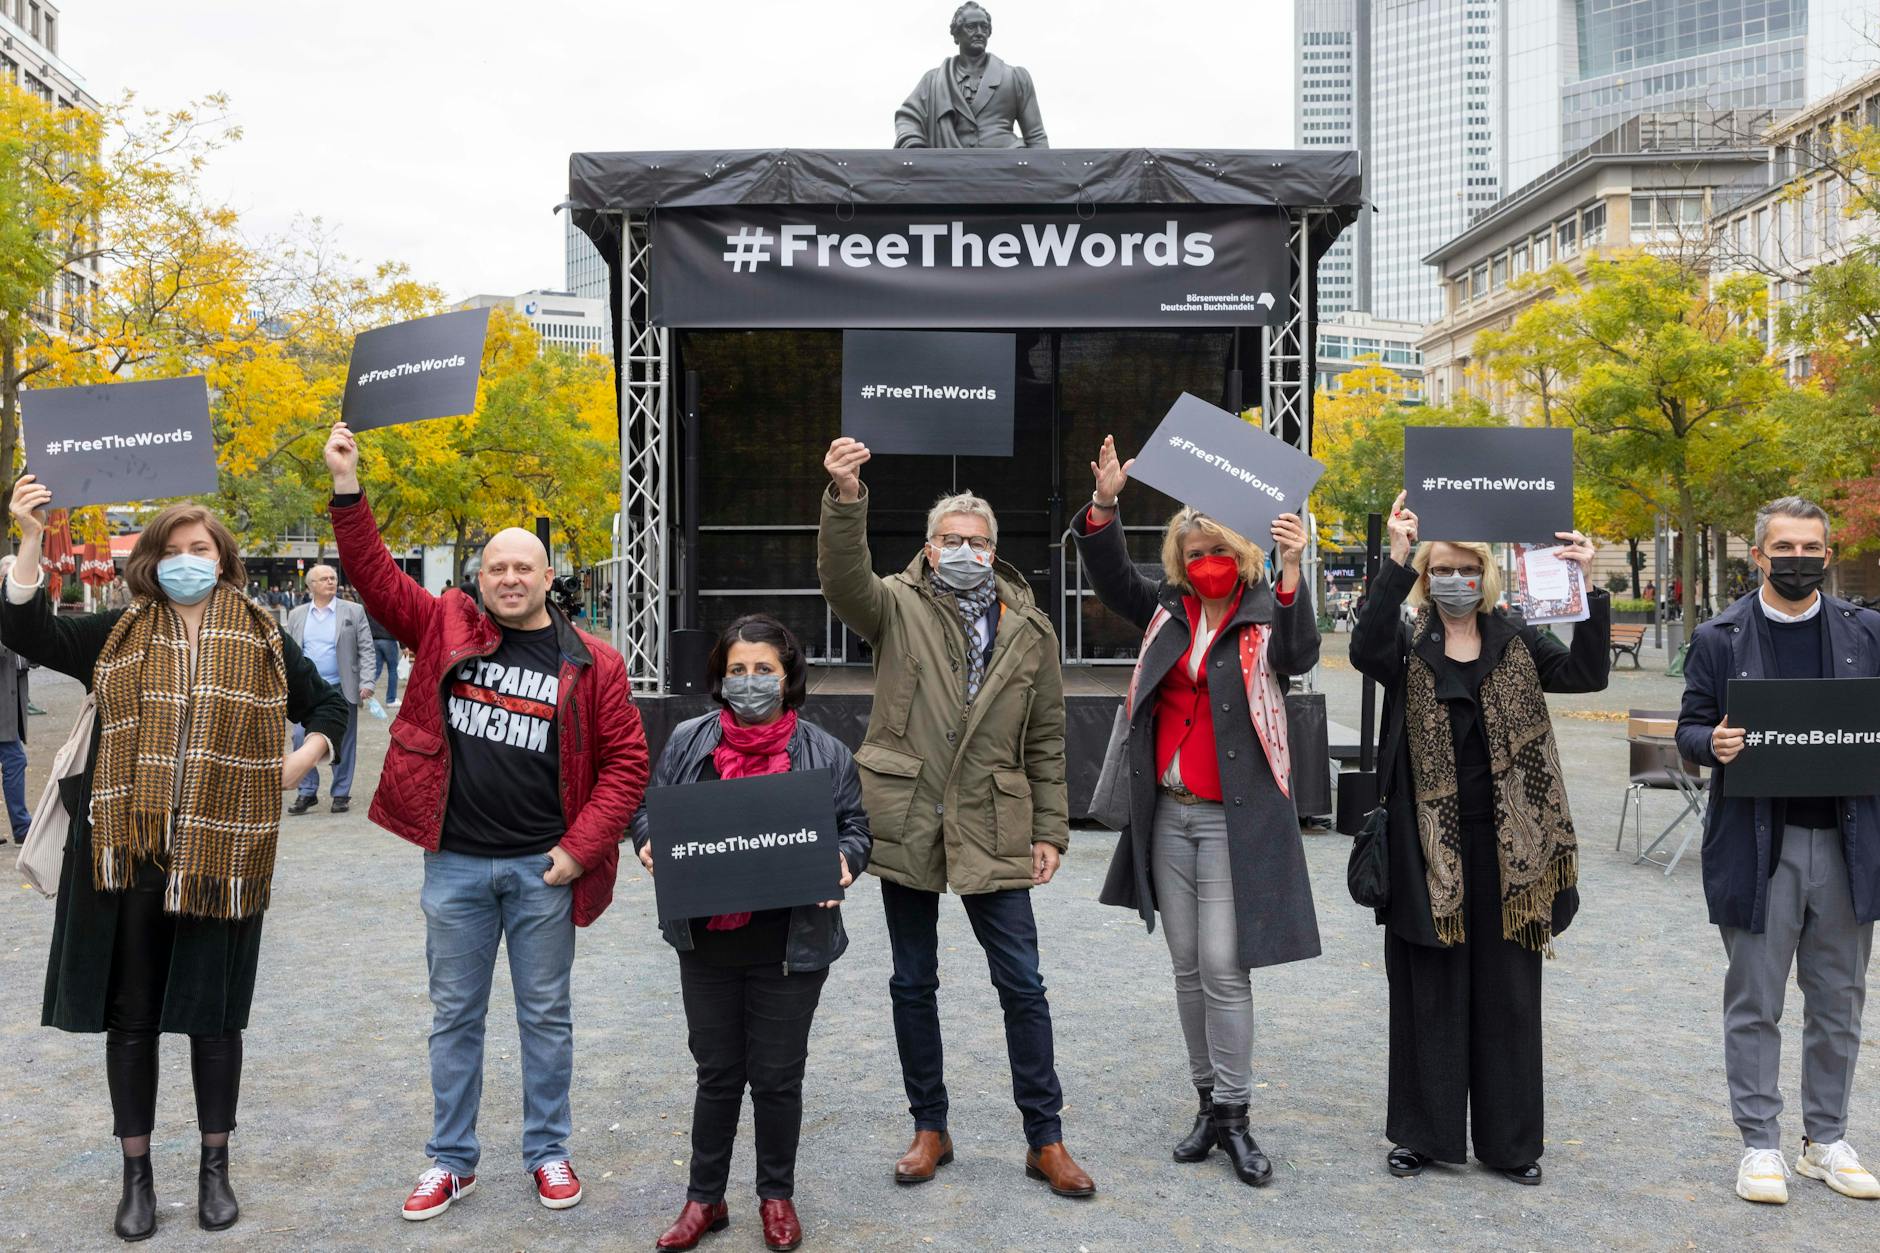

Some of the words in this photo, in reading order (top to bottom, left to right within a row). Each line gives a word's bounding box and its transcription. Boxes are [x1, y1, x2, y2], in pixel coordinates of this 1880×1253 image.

[723, 221, 1215, 273] #FreeTheWords
[1160, 303, 1202, 312] Deutschen
[1203, 303, 1255, 312] Buchhandels
[1186, 293, 1239, 302] Börsenverein
[1240, 293, 1255, 302] des
[357, 354, 466, 386] #FreeTheWords
[860, 384, 997, 400] #FreeTheWords
[45, 428, 193, 456] #FreeTheWords
[1168, 436, 1286, 502] #FreeTheWords
[1422, 477, 1556, 492] #FreeTheWords
[457, 657, 559, 705] СТРАНА
[448, 695, 550, 753] ЖИЗНИ
[671, 828, 818, 860] #FreeTheWords
